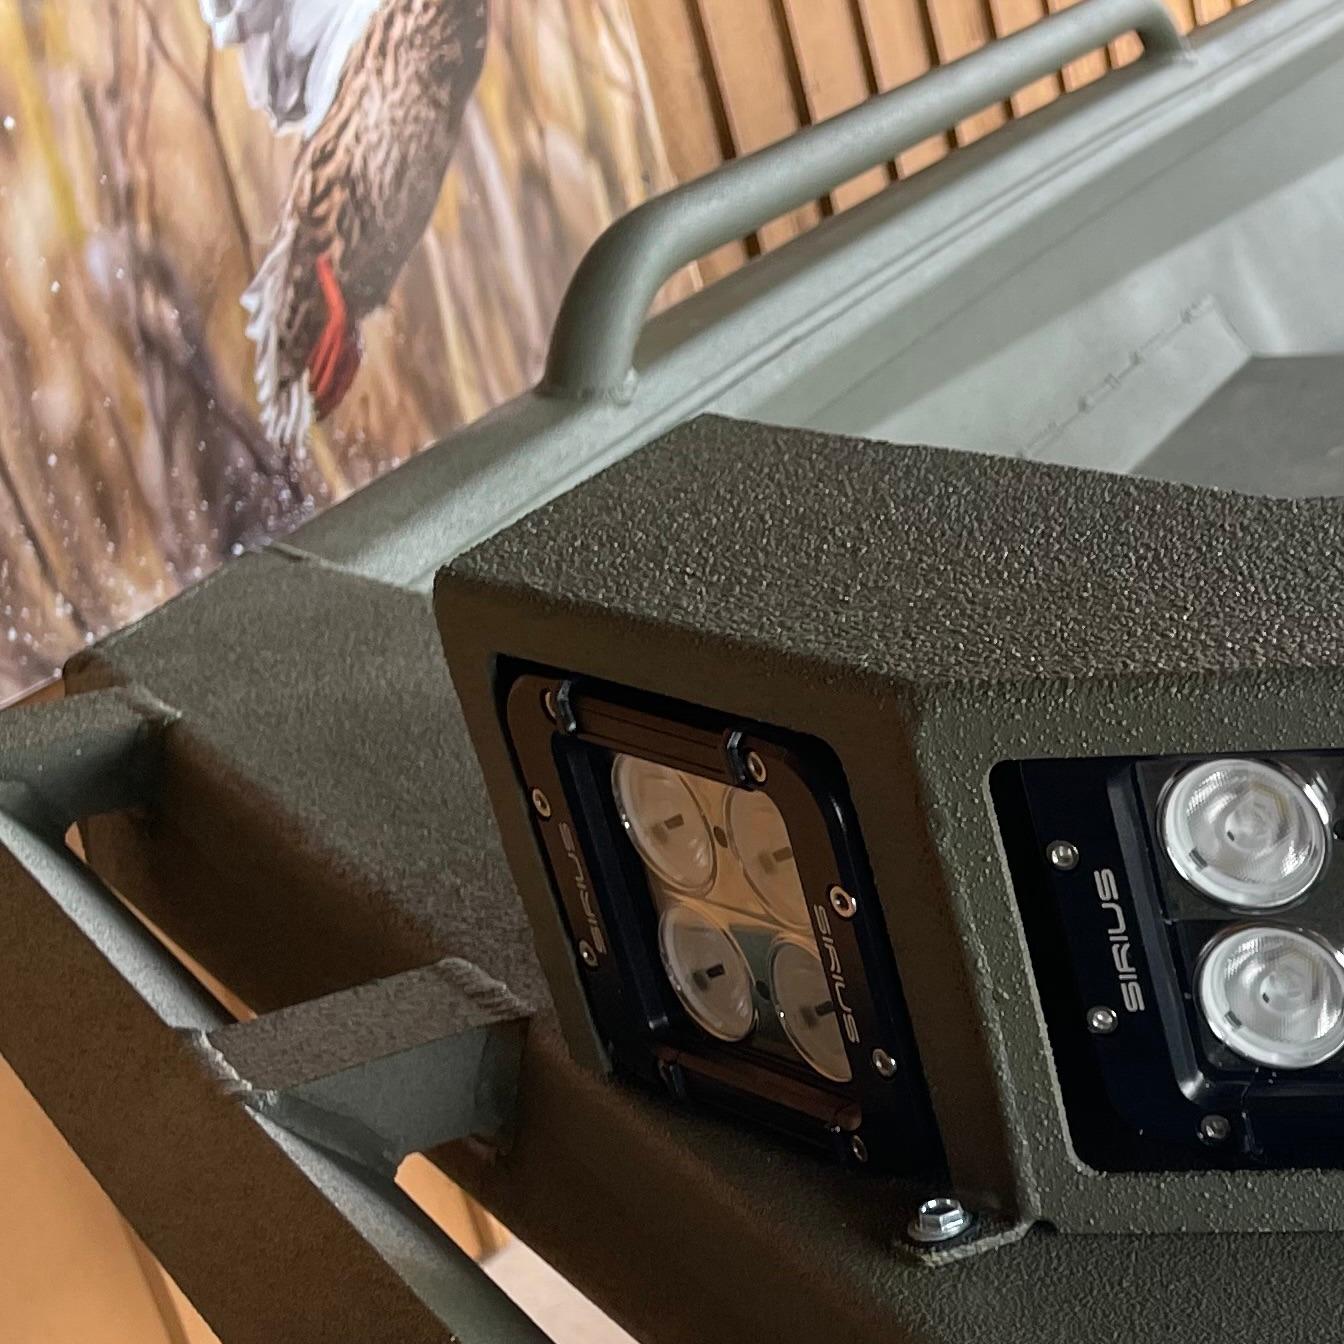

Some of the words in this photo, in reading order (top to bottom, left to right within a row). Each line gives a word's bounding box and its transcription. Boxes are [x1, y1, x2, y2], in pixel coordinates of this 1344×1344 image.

[557, 821, 606, 954] SIRIUS
[1094, 869, 1144, 1011] SIRIUS
[814, 904, 859, 1043] SIRIUS
